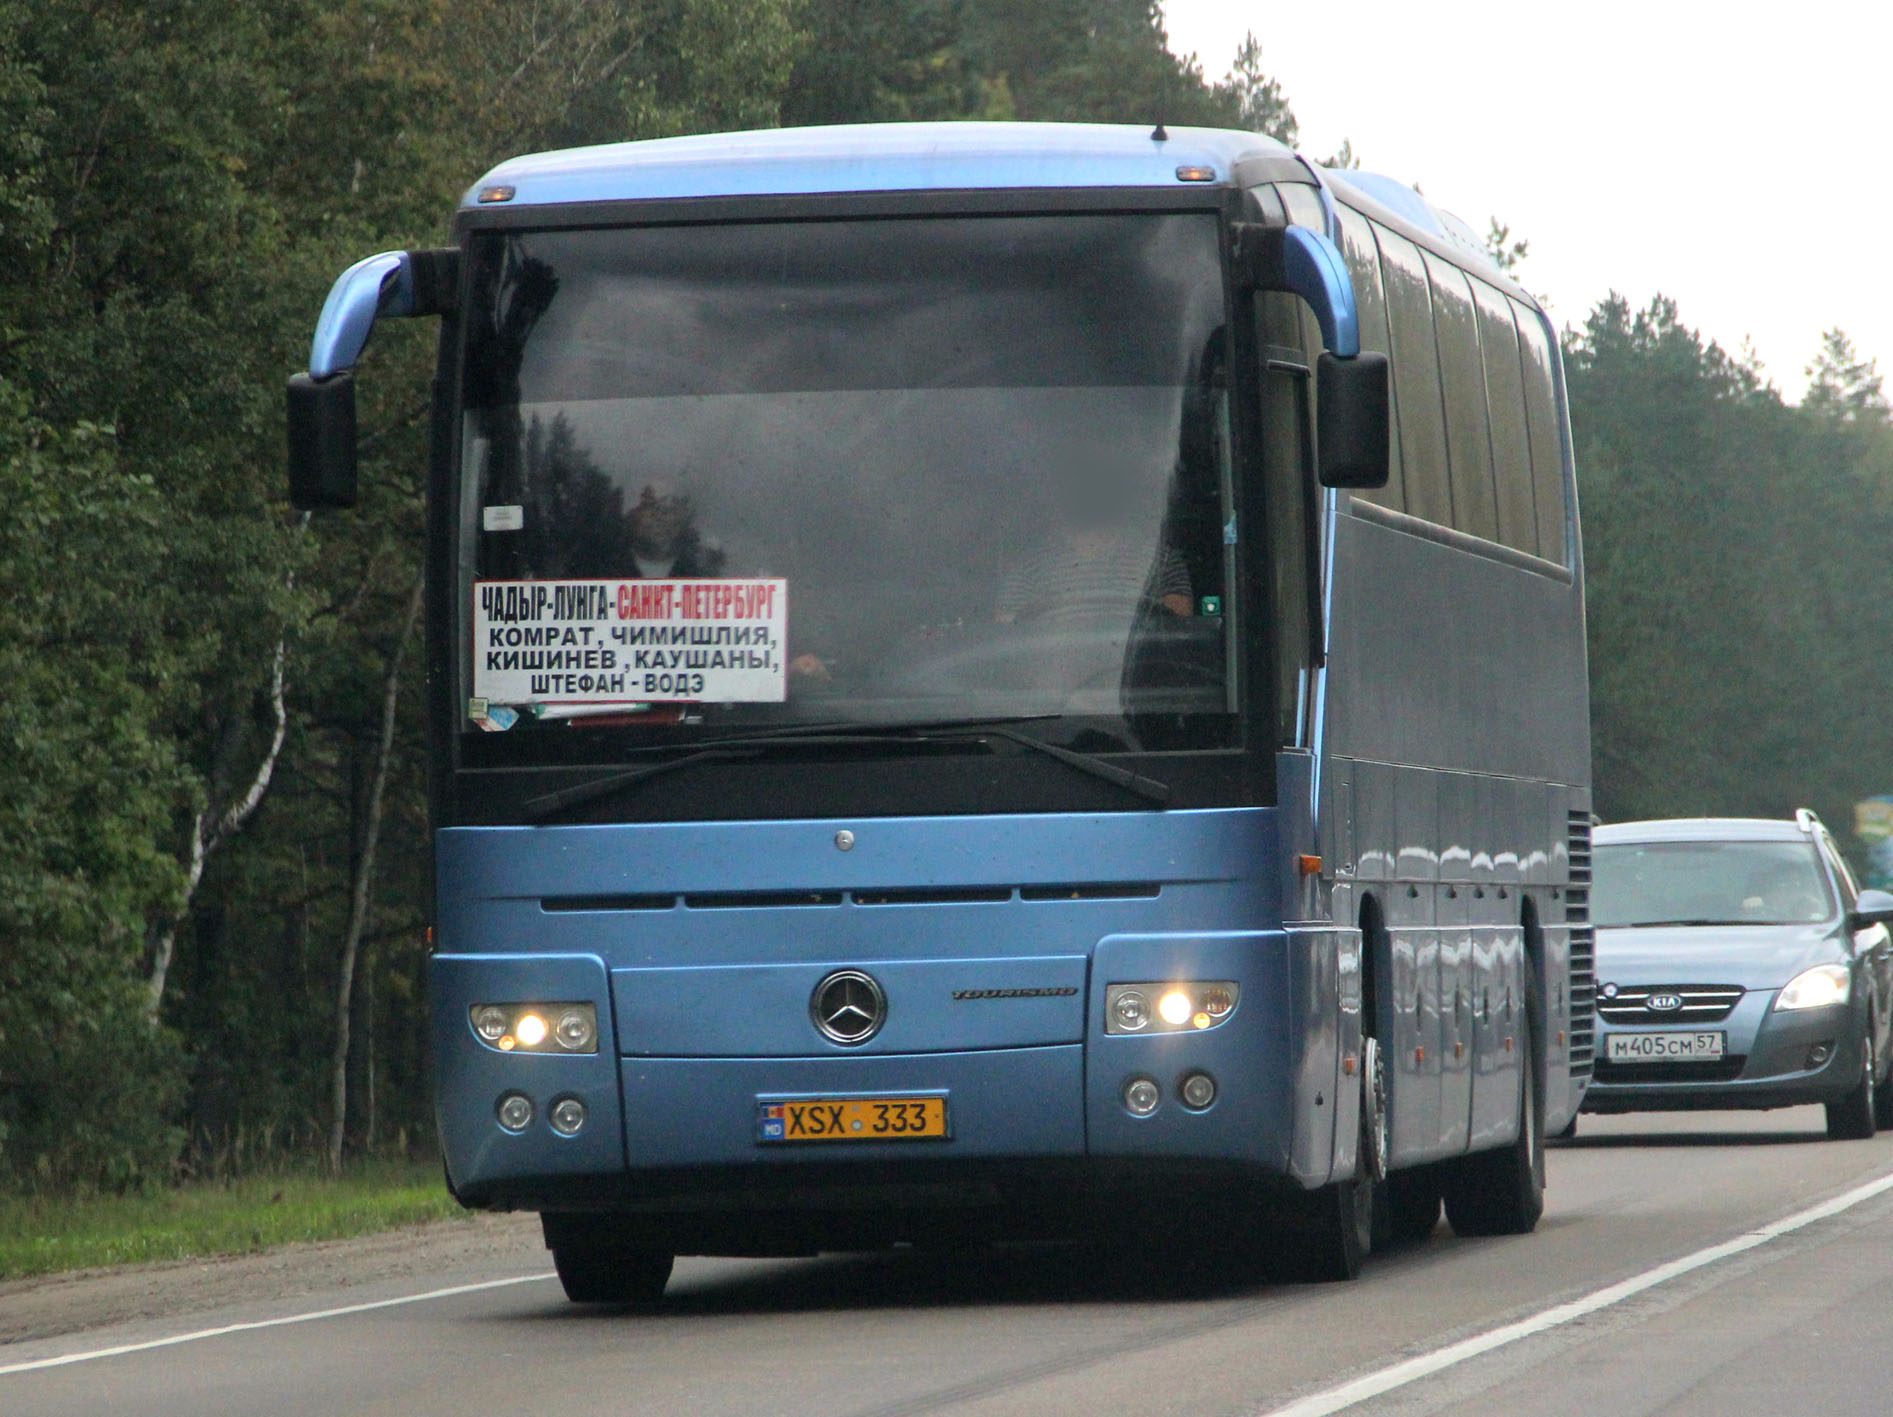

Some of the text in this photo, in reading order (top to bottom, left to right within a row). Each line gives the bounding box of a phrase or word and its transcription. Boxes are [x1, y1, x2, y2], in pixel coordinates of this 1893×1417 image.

[489, 625, 777, 649] КОМРАТ, ЧИМИШЛИЯ,
[635, 649, 779, 673] КАУШАНЫ,
[952, 987, 1079, 1000] TOURISMO
[1652, 998, 1676, 1007] KIA
[1697, 1035, 1715, 1048] 57
[789, 1103, 927, 1135] XSX 333
[764, 1123, 782, 1136] MD
